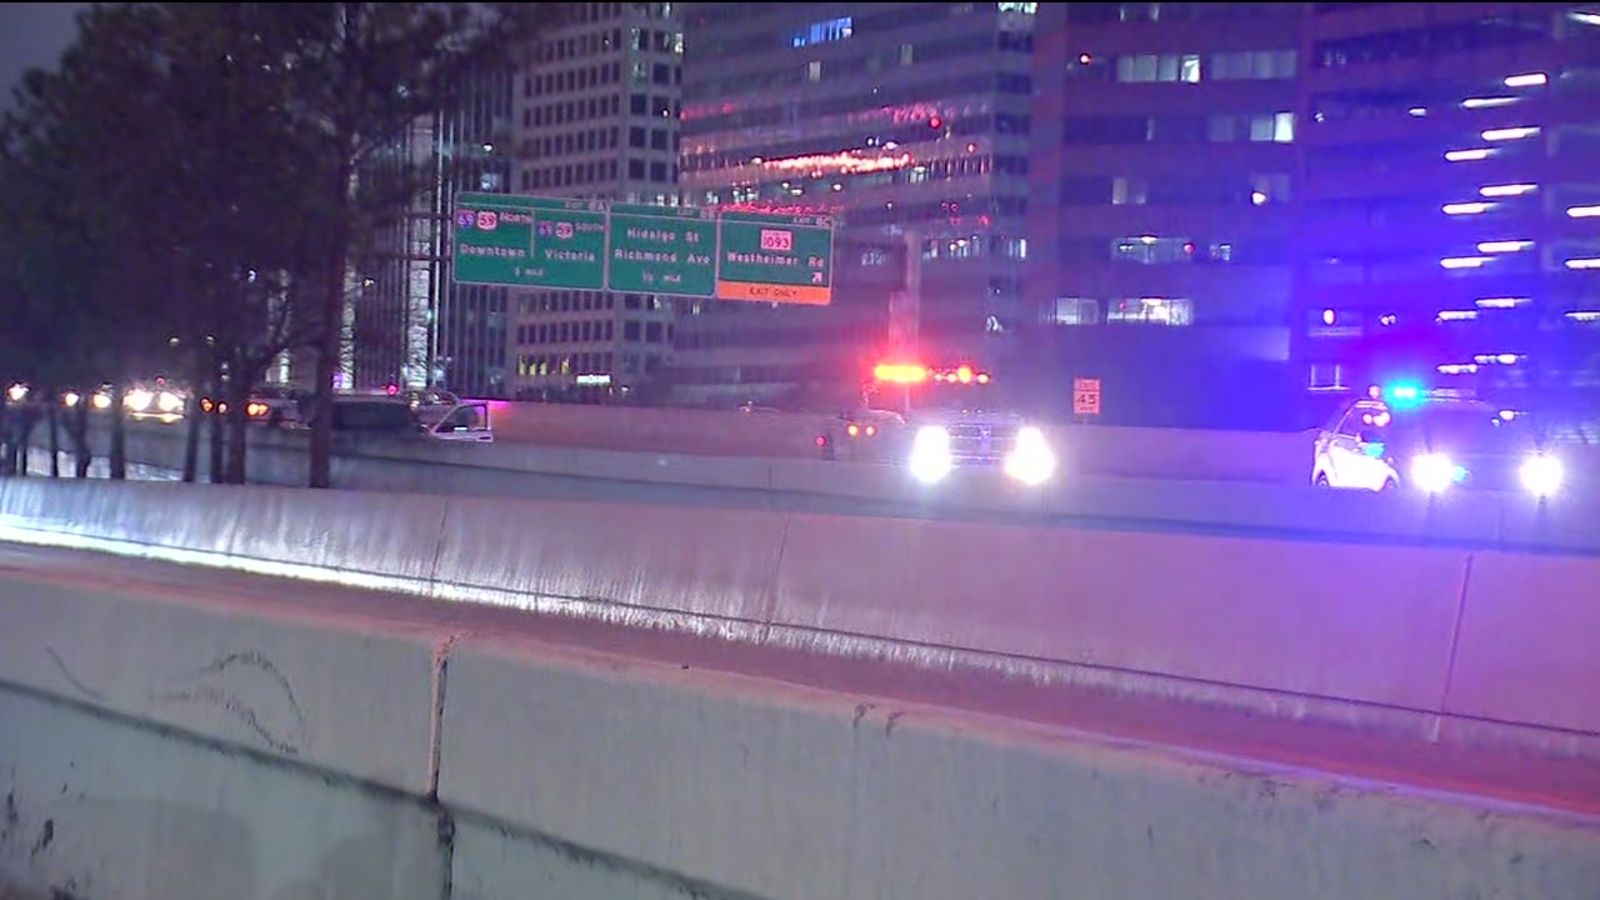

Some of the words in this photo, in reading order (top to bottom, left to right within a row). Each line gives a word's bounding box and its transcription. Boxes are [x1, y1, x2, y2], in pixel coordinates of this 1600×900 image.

[627, 228, 675, 243] Hidalgo
[685, 231, 699, 242] St
[763, 236, 789, 249] 1093
[460, 243, 525, 257] Downtown
[544, 248, 595, 261] Victoria
[614, 248, 677, 262] Richmond
[687, 253, 710, 265] Ave
[727, 252, 799, 265] Westheimer
[808, 256, 824, 267] Rd
[749, 286, 770, 296] EXIT
[773, 288, 798, 297] ONLY
[1077, 394, 1096, 404] 45
